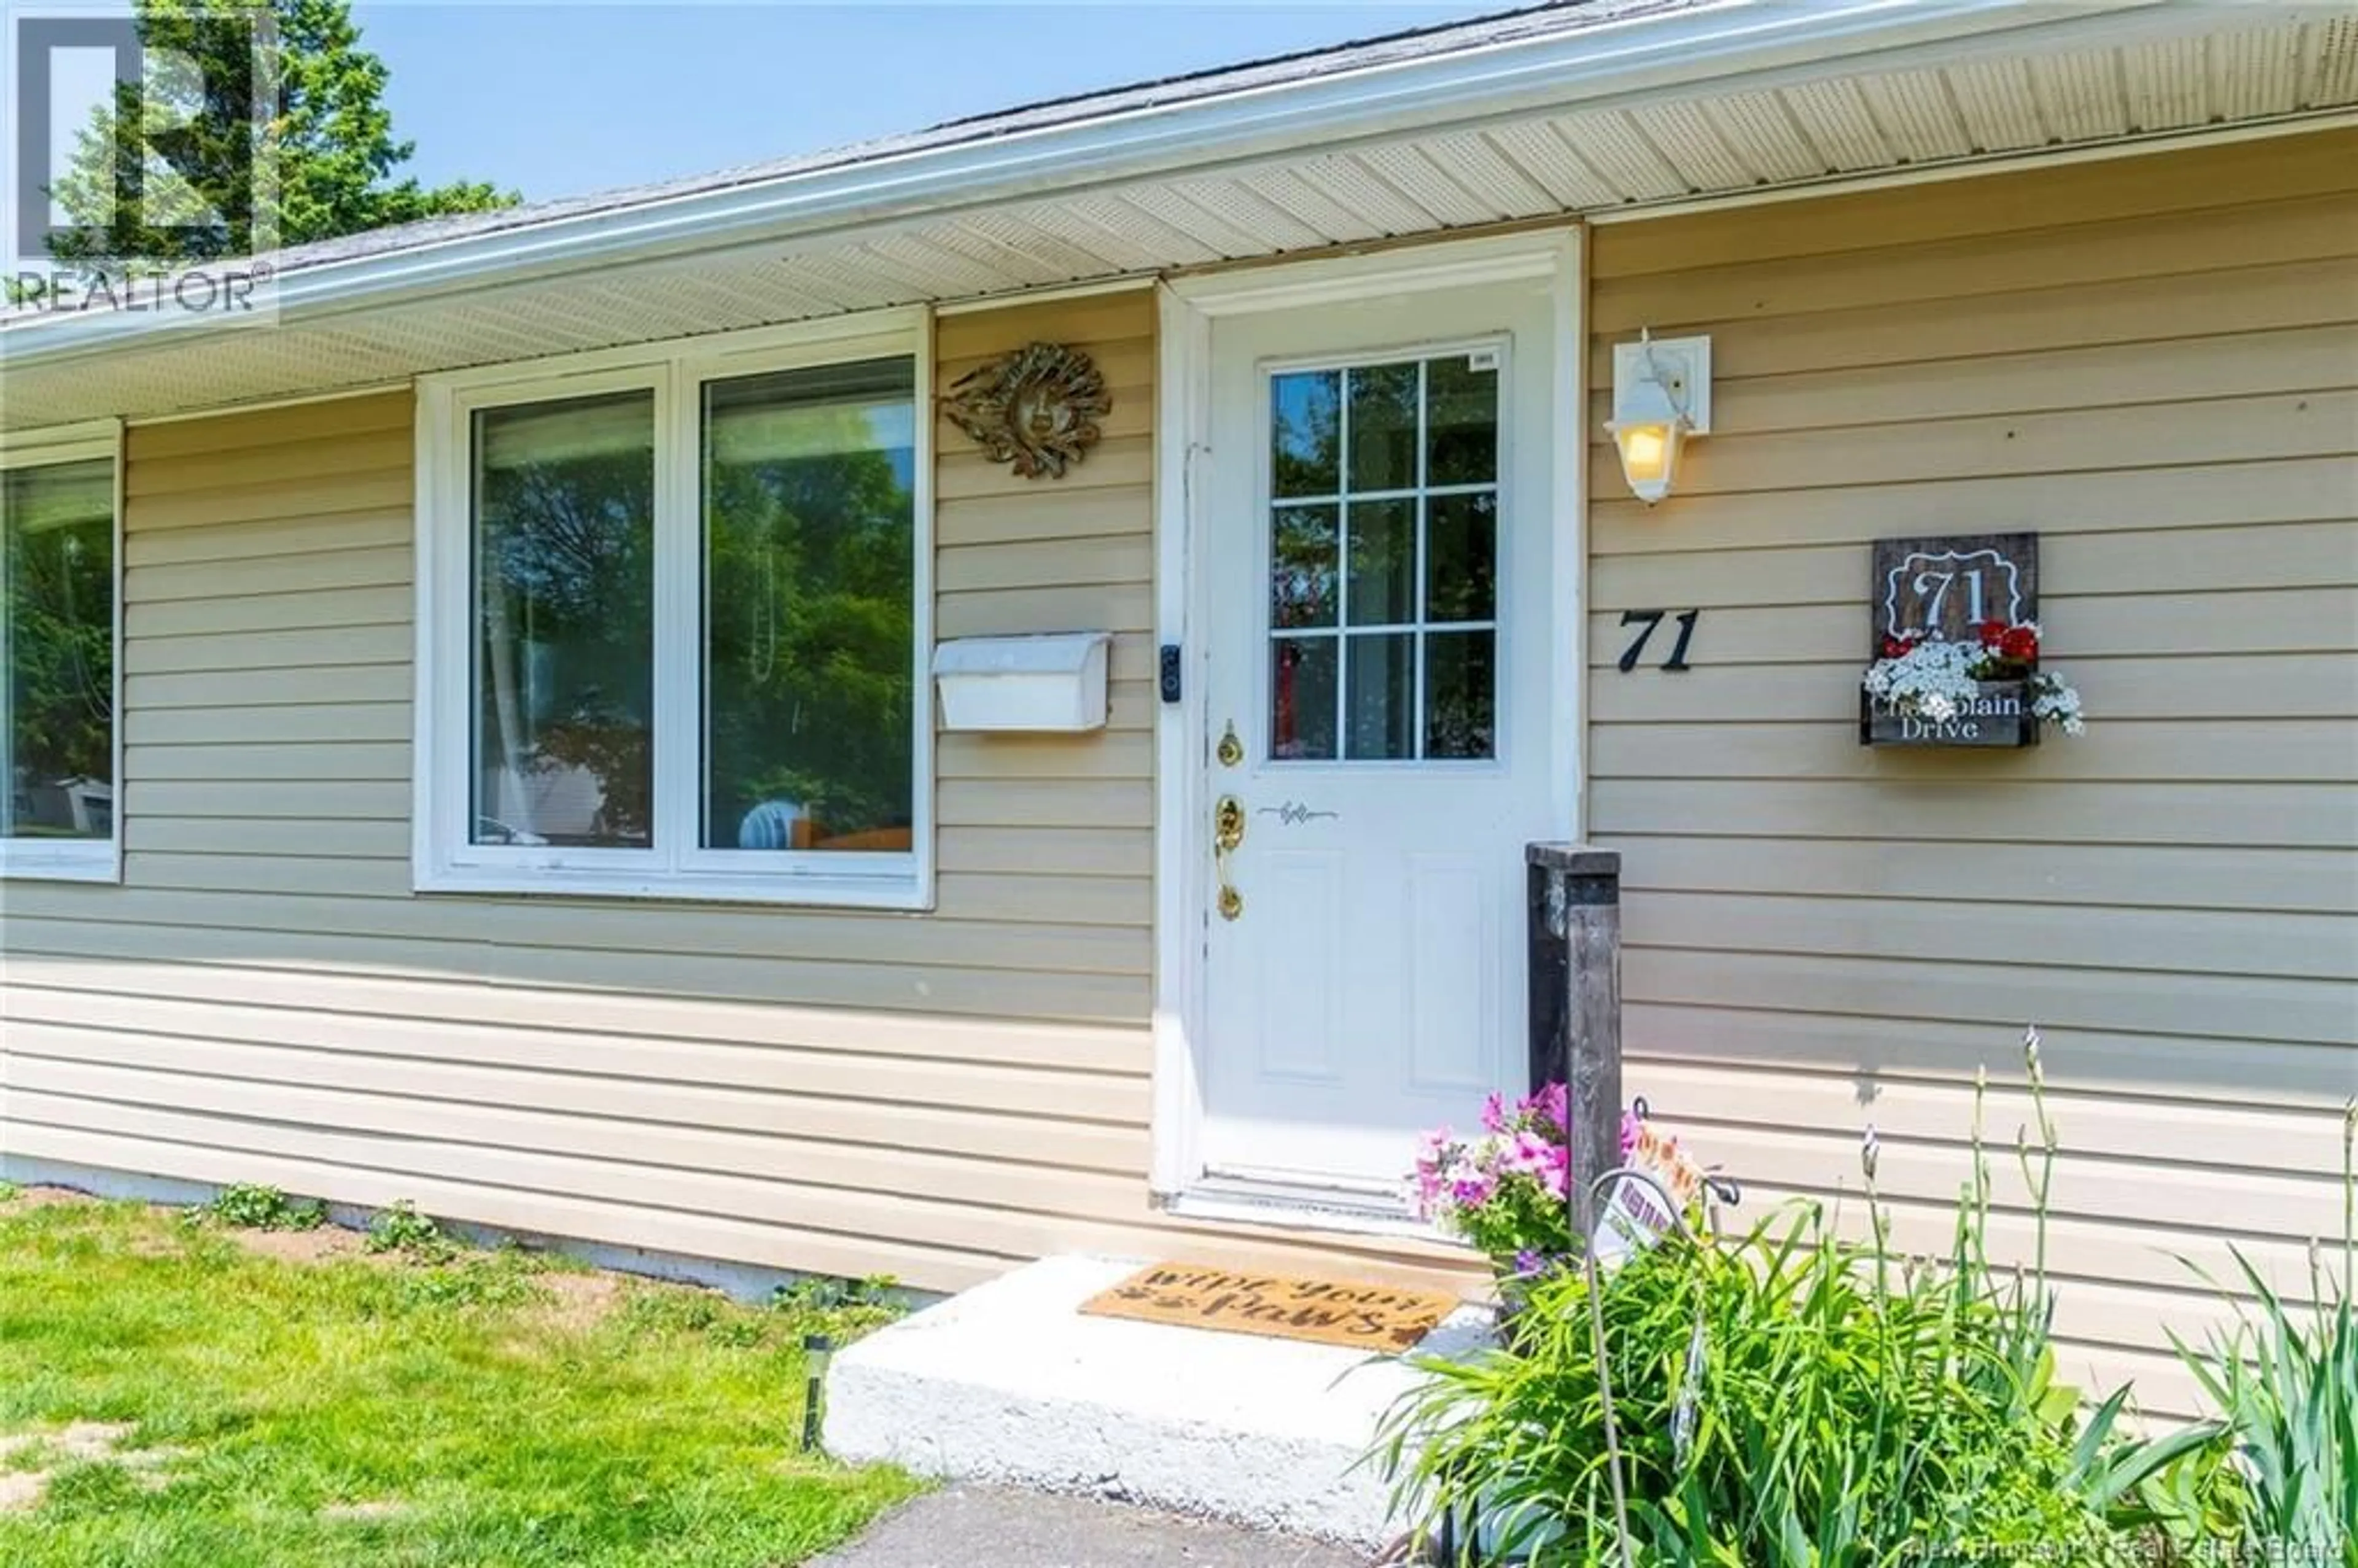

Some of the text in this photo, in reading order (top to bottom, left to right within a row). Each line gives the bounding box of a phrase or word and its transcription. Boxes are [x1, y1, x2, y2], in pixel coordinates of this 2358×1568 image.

[1913, 569, 1985, 626] 71
[1619, 608, 1698, 673] 71
[1901, 717, 1979, 739] Drive
